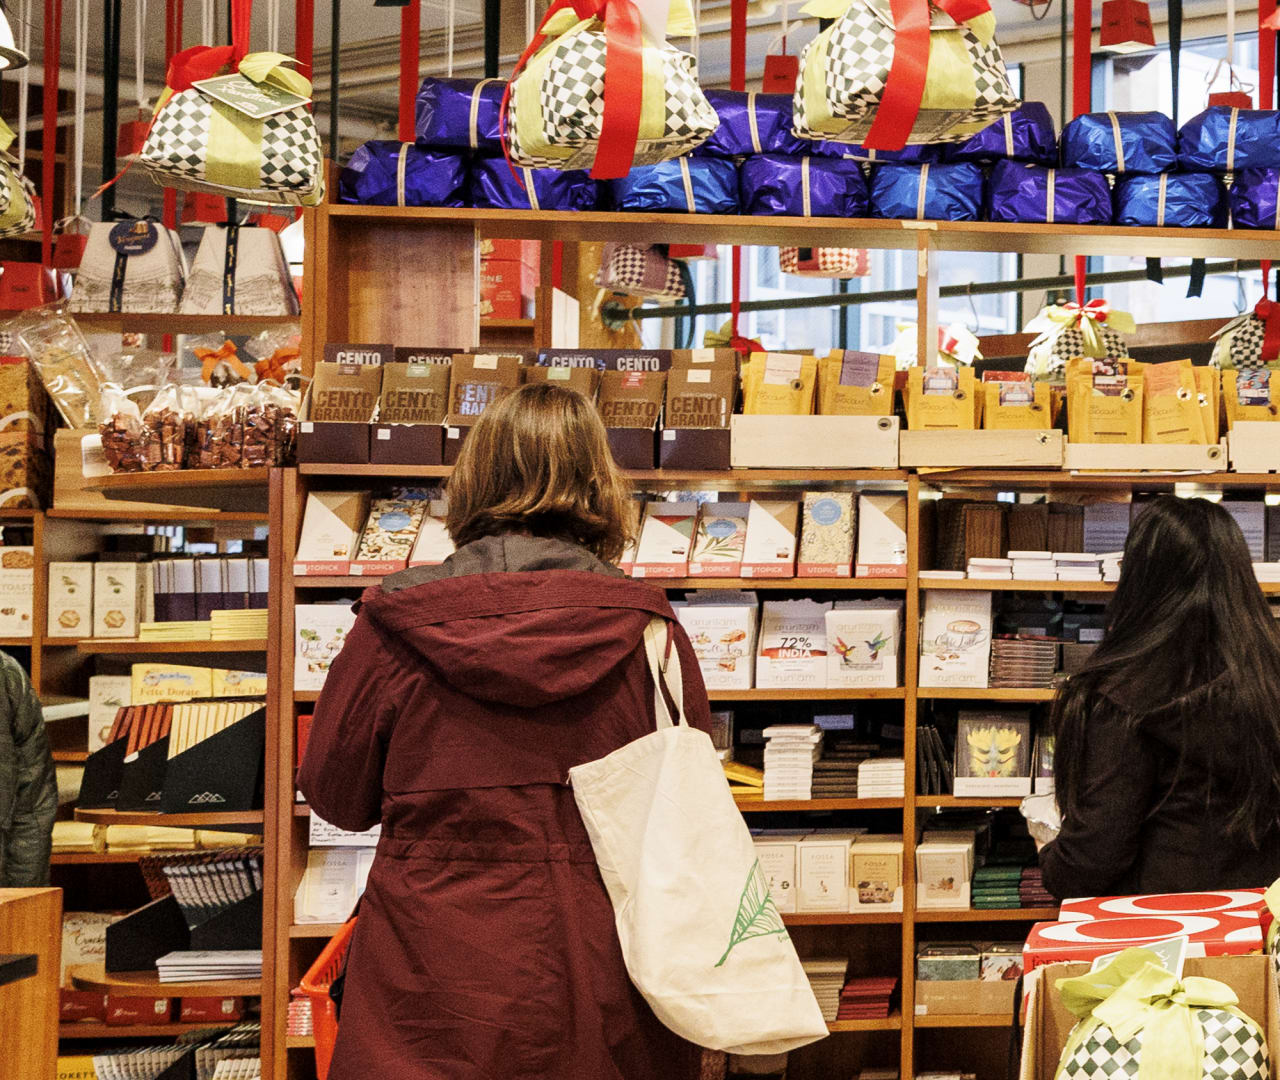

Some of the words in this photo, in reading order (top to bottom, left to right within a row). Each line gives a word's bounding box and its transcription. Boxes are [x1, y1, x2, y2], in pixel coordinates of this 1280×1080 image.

[336, 352, 381, 366] CENTO
[551, 356, 595, 368] CENTO
[616, 357, 660, 371] CENTO
[317, 391, 372, 408] CENTO
[603, 401, 656, 417] CENTO
[780, 637, 812, 649] 72%
[777, 649, 812, 659] INDIA
